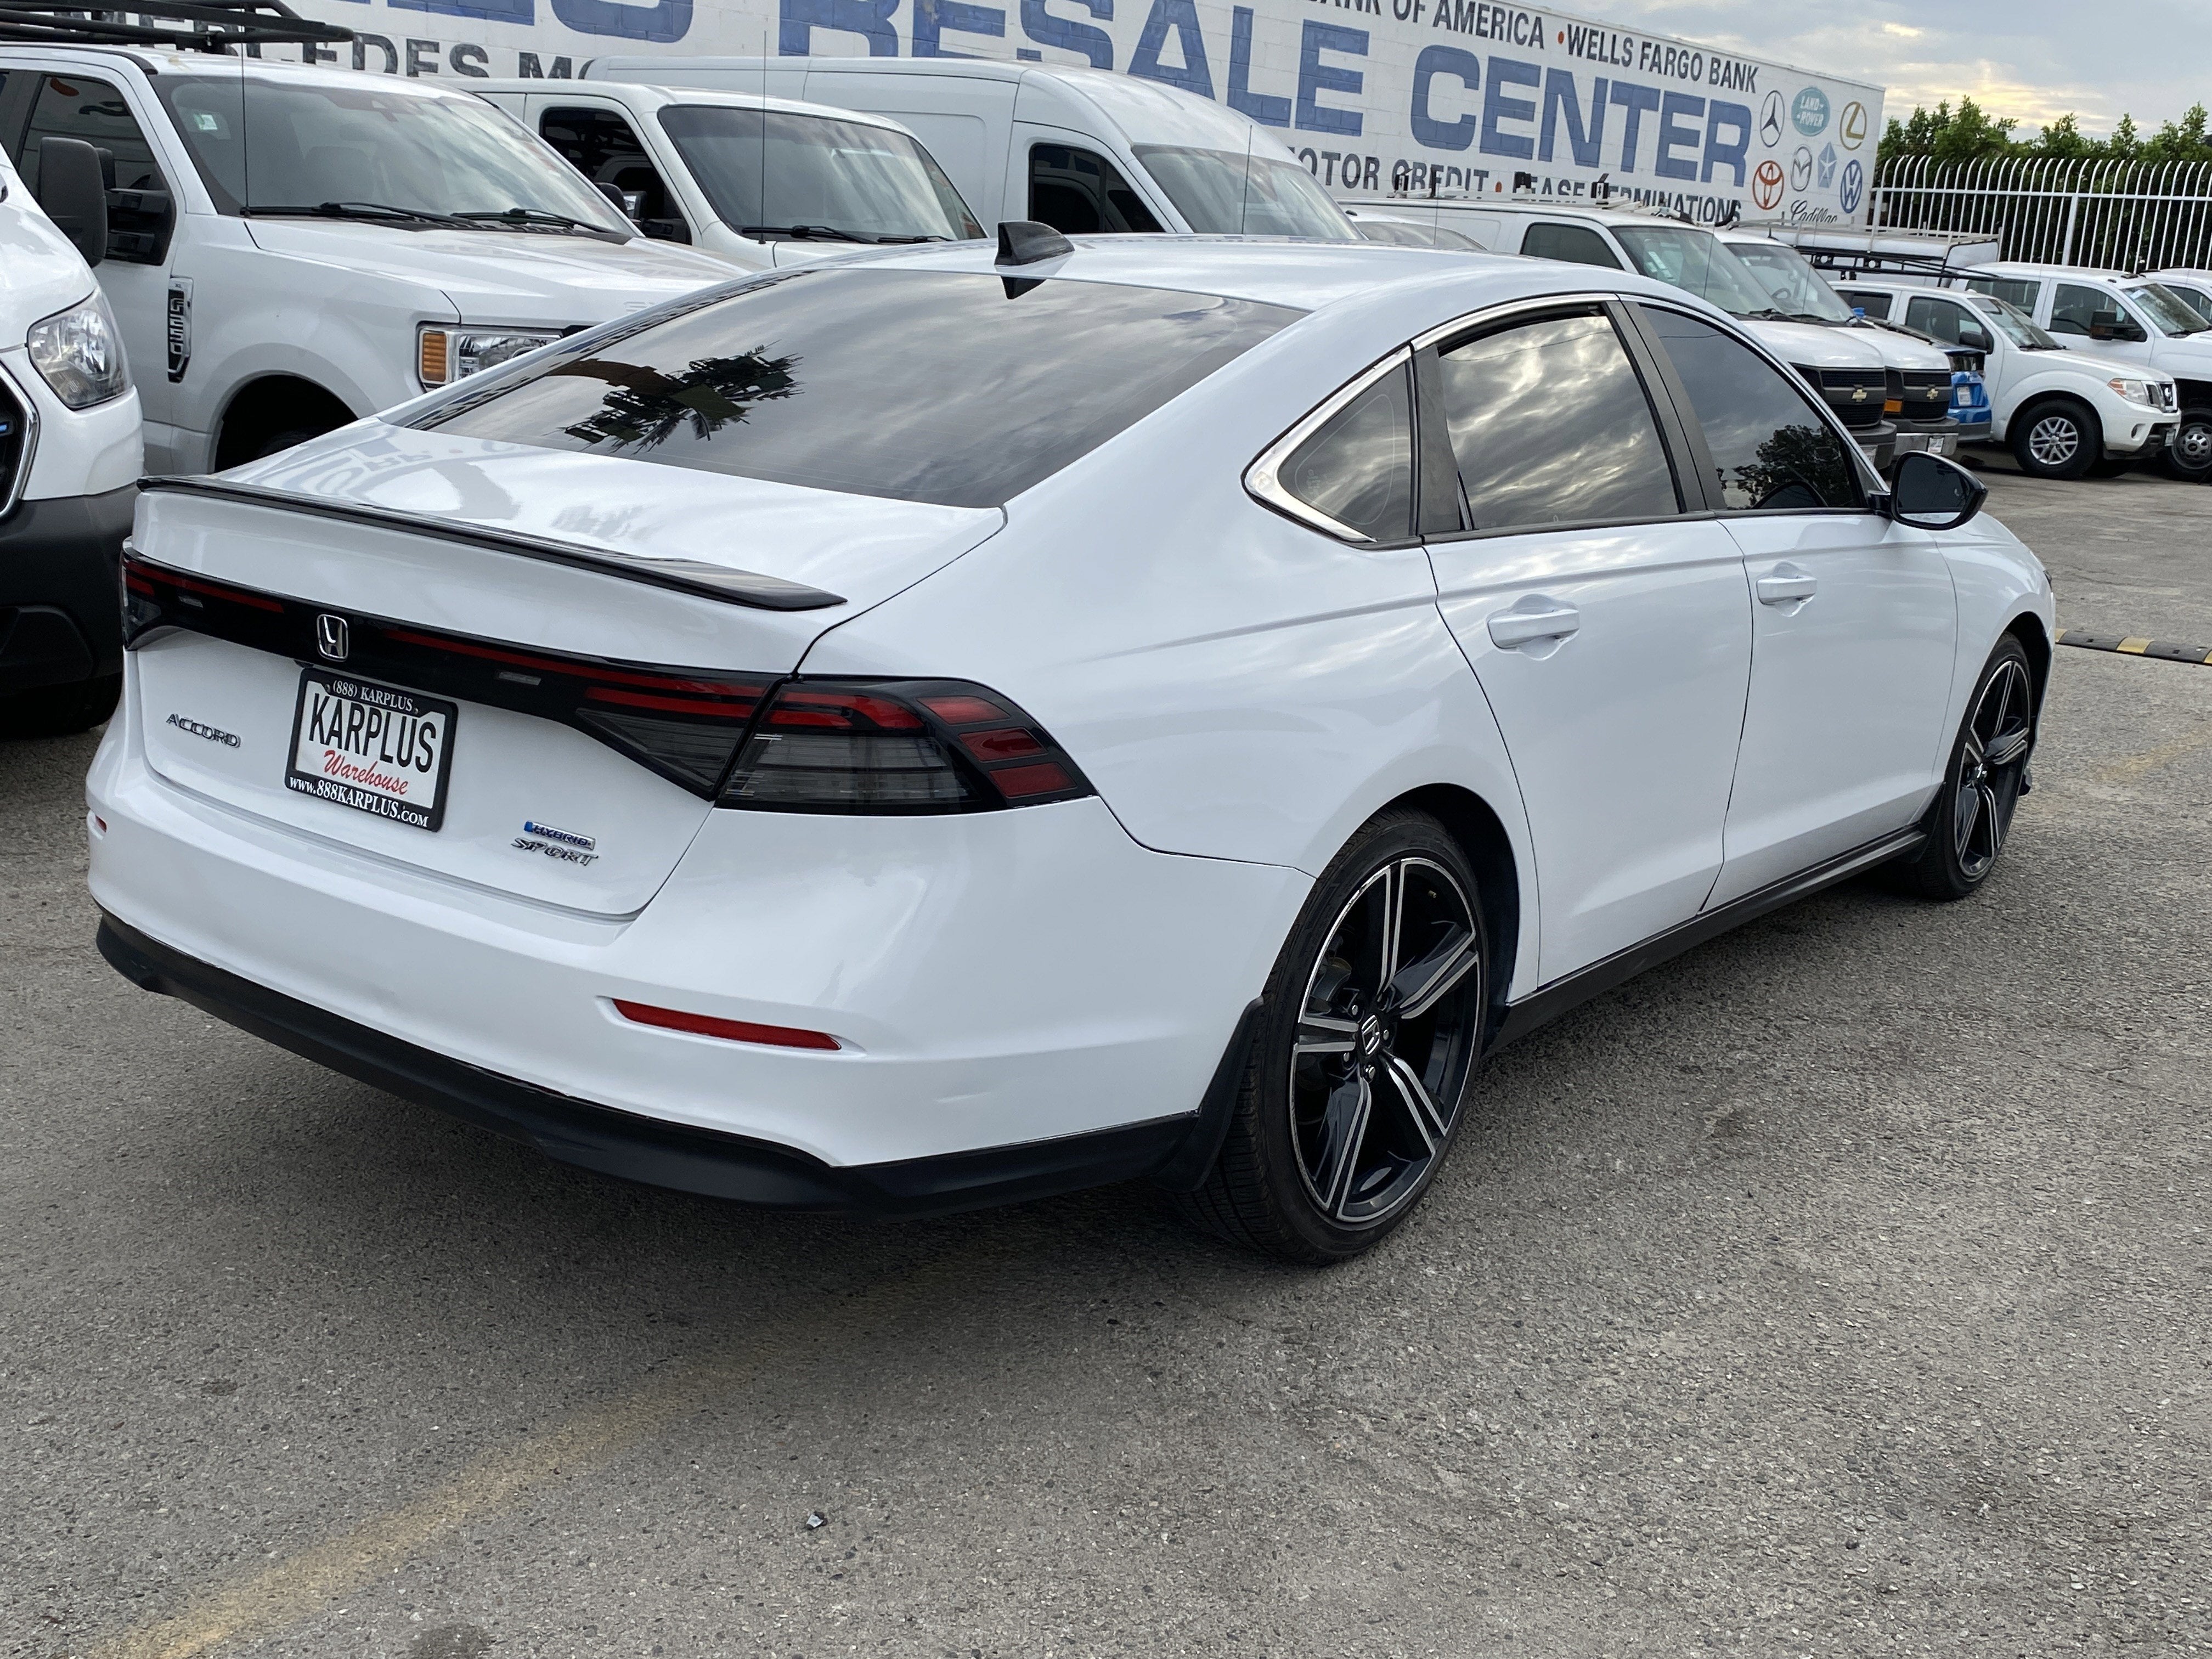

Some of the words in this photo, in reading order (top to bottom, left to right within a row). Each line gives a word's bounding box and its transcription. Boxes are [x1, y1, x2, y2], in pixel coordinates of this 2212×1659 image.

[1432, 0, 1544, 49] AMERICA
[1566, 24, 1633, 67] WELLS
[1639, 41, 1703, 81] FARGO
[1708, 56, 1759, 94] BANK
[1410, 44, 1752, 187] CENTER
[1288, 146, 1380, 190] OTOR
[333, 680, 358, 697] (888)
[360, 686, 414, 712] KARPLUS
[166, 714, 241, 748] ACCORD
[308, 692, 437, 773] KARPLUS
[324, 749, 409, 795] Warehouse
[511, 837, 599, 867] SPORT
[533, 825, 589, 846] HYBRID
